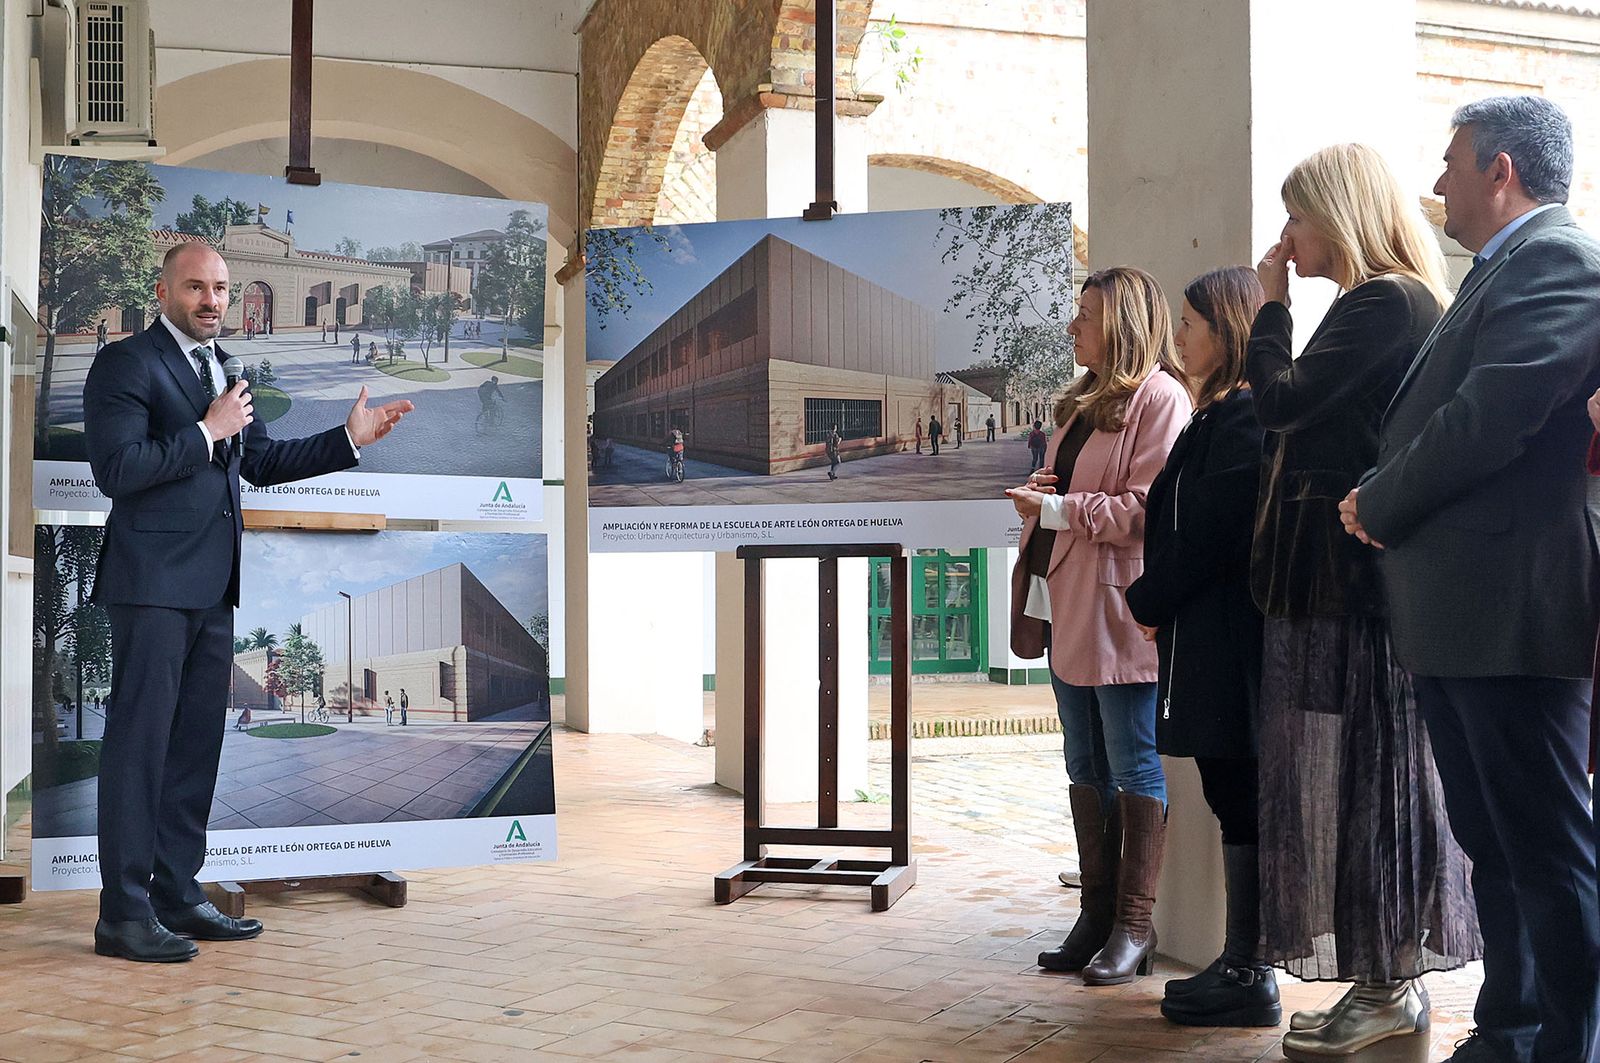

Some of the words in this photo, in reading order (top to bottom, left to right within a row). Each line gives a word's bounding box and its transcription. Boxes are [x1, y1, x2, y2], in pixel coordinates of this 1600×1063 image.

[49, 478, 95, 488] AMPLIACI
[240, 485, 246, 493] E
[247, 485, 270, 494] ARTE
[272, 484, 296, 495] LEÓN
[297, 486, 333, 496] ORTEGA
[334, 487, 346, 496] DE
[347, 488, 381, 497] HUELVA
[49, 488, 90, 499] Proyecto:
[602, 520, 651, 531] AMPLIACIÓN
[652, 522, 659, 530] Y
[660, 521, 698, 530] REFORMA
[700, 521, 710, 529] DE
[712, 521, 723, 529] LA
[724, 520, 761, 529] ESCUELA
[762, 520, 773, 529] DE
[774, 520, 795, 528] ARTE
[797, 518, 819, 528] LEÓN
[821, 519, 856, 528] ORTEGA
[857, 519, 868, 527] DE
[870, 518, 903, 527] HUELVA
[602, 532, 636, 542] Proyecto:
[637, 531, 664, 541] Urbanz
[665, 531, 710, 542] Arquitectura
[711, 533, 716, 541] y
[717, 530, 760, 540] Urbanismo,
[761, 530, 774, 539] S.L.
[51, 853, 98, 864] AMPLIACI
[204, 847, 240, 857] SCUELA
[241, 846, 253, 855] DE
[254, 845, 278, 854] ARTE
[280, 842, 304, 853] LEÓN
[306, 842, 342, 852] ORTEGA
[344, 841, 355, 850] DE
[357, 839, 391, 849] HUELVA
[51, 866, 94, 877] Proyecto:
[204, 857, 239, 868] anismo,
[240, 856, 256, 866] S.L.
